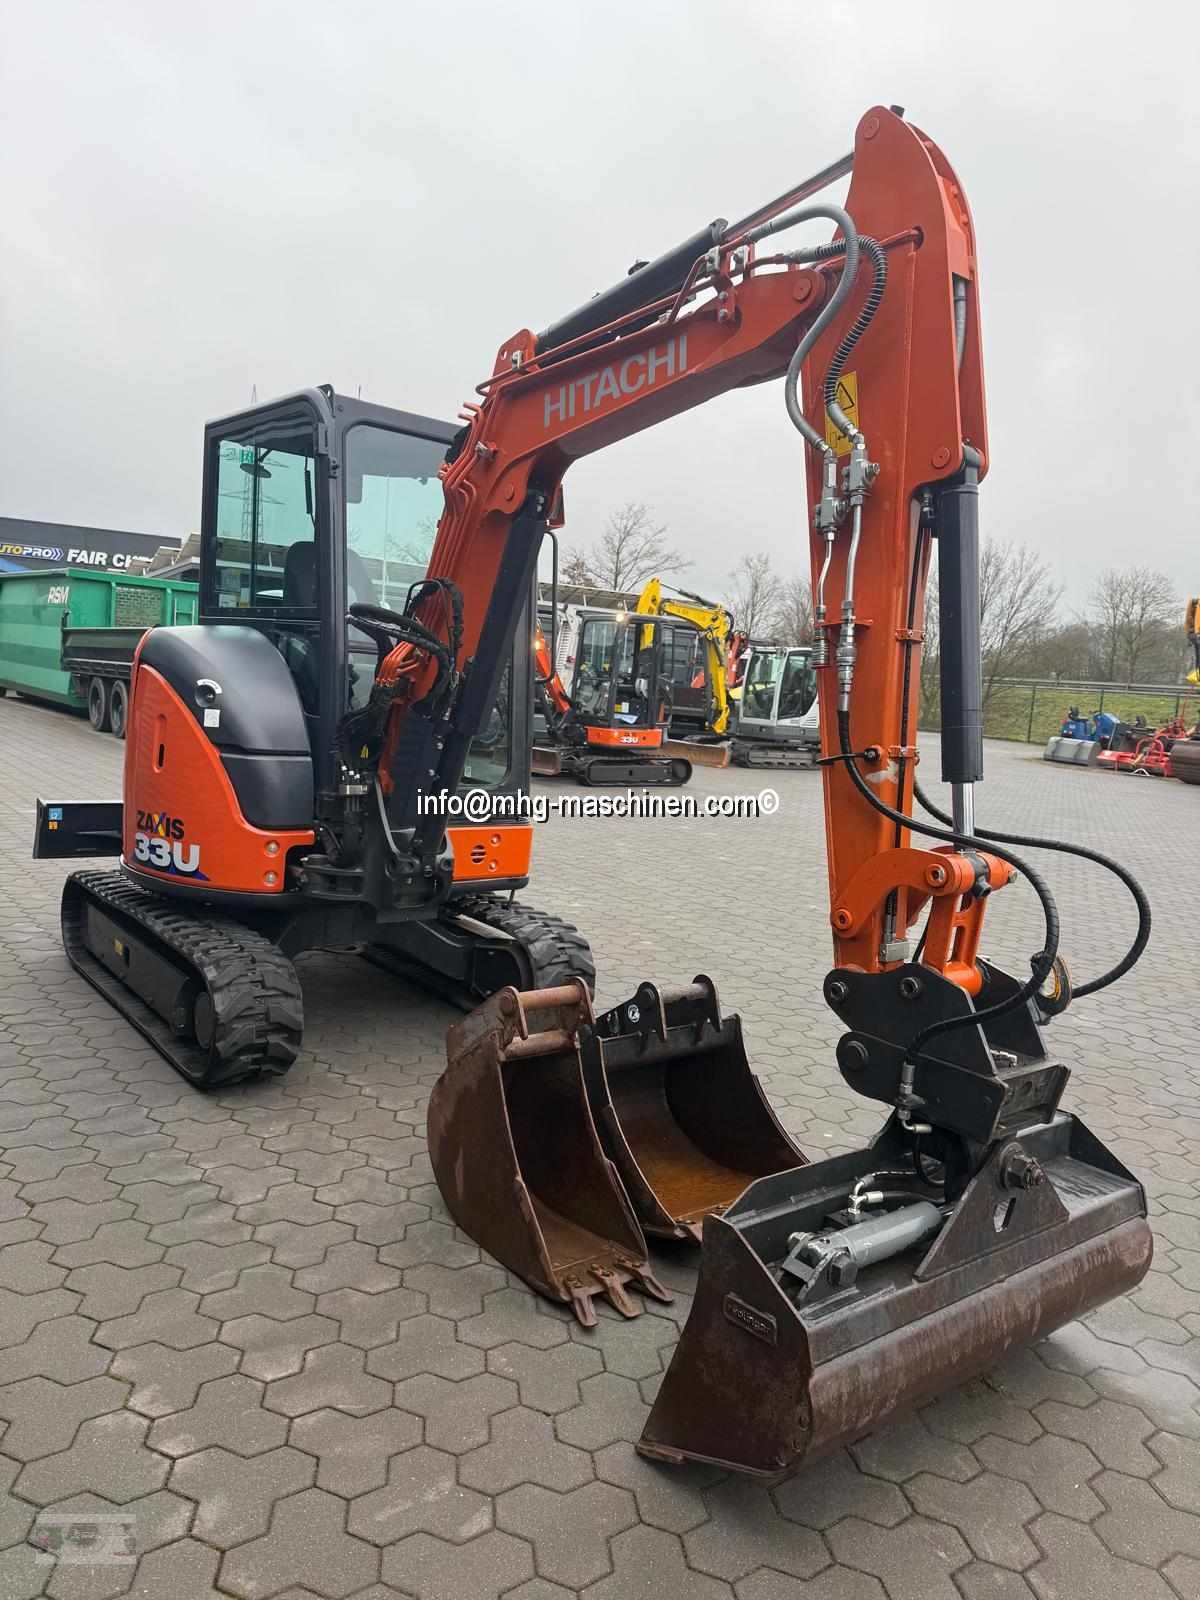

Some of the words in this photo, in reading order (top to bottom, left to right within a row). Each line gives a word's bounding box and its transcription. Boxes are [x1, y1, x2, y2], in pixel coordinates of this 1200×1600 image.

[543, 335, 688, 428] HITACHI
[67, 549, 108, 567] FAIR
[136, 810, 185, 840] ZAXIS
[135, 832, 200, 872] 33U
